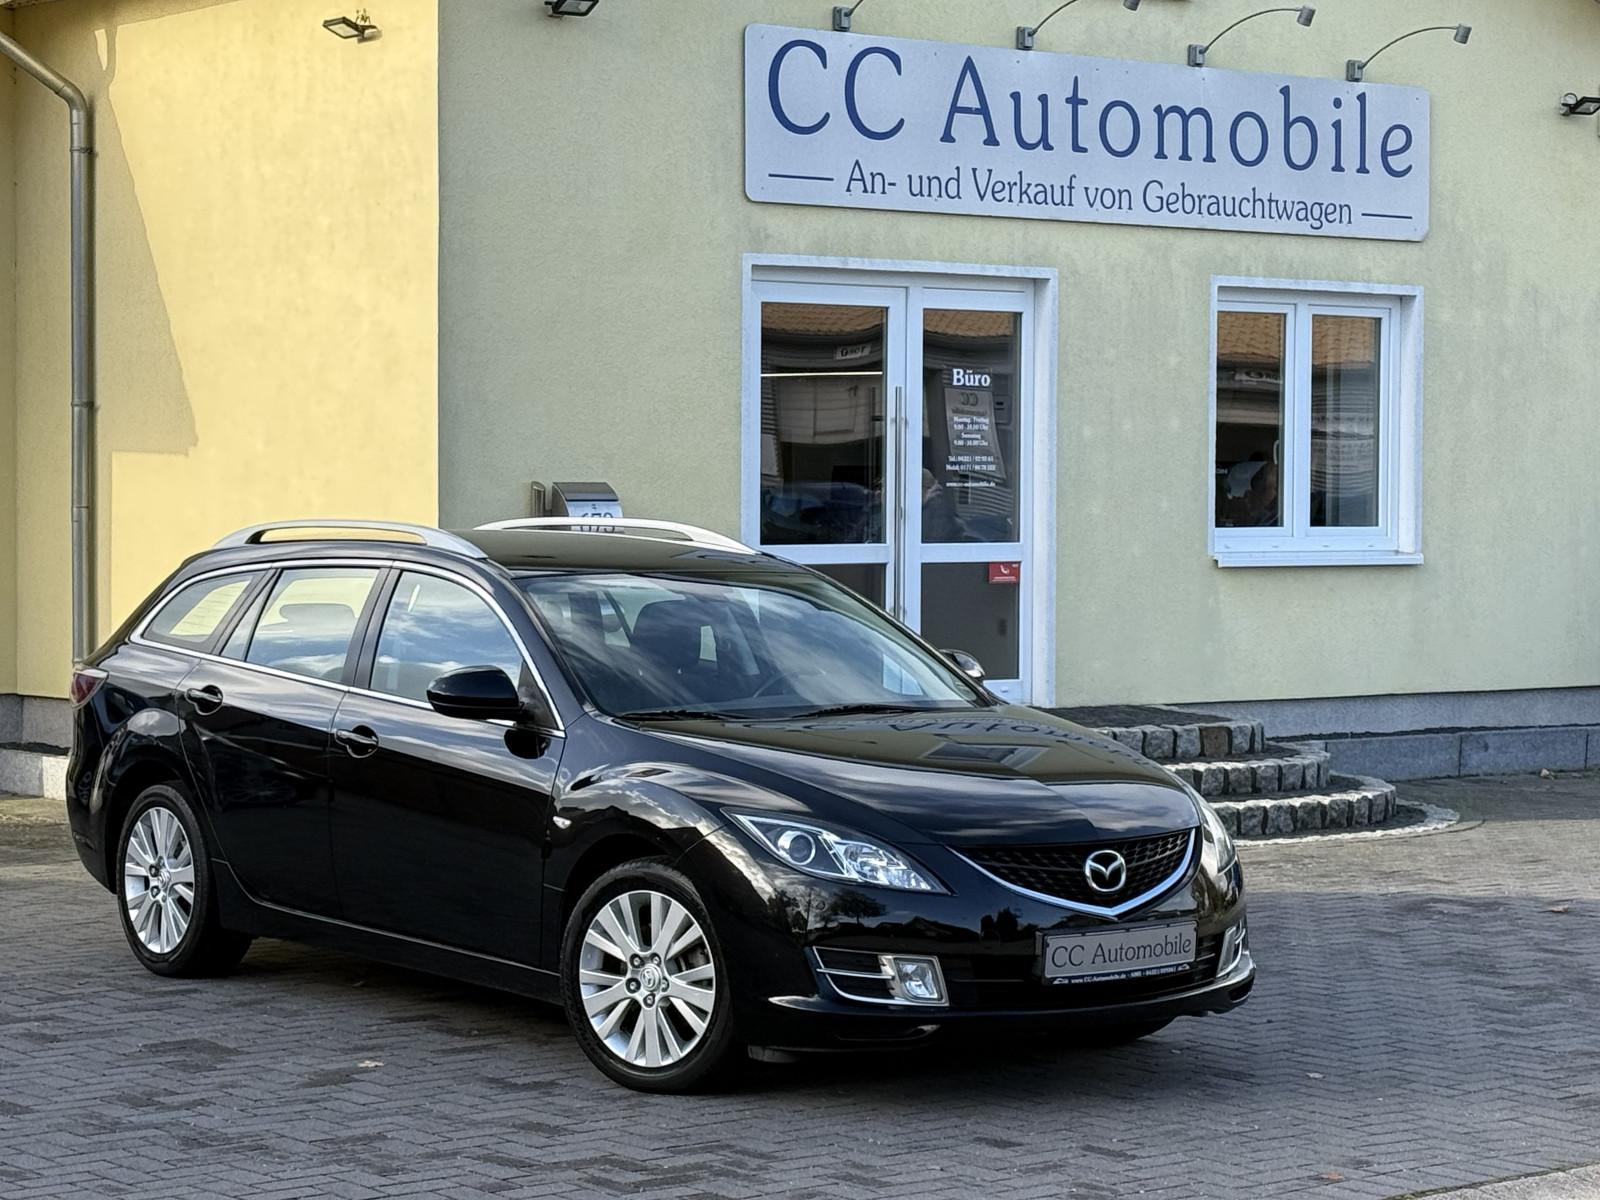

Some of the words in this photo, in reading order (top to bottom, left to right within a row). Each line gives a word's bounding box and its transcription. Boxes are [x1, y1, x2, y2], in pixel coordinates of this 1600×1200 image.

[767, 39, 906, 141] CC
[939, 55, 1414, 179] Automobile
[845, 159, 897, 195] An-
[907, 165, 962, 200] und
[971, 167, 1077, 208] Verkauf
[1083, 186, 1134, 211] von
[1142, 179, 1353, 231] Gebrauchtwagen
[952, 367, 991, 387] Büro
[1051, 944, 1085, 968] CC
[1091, 932, 1192, 965] Automobile
